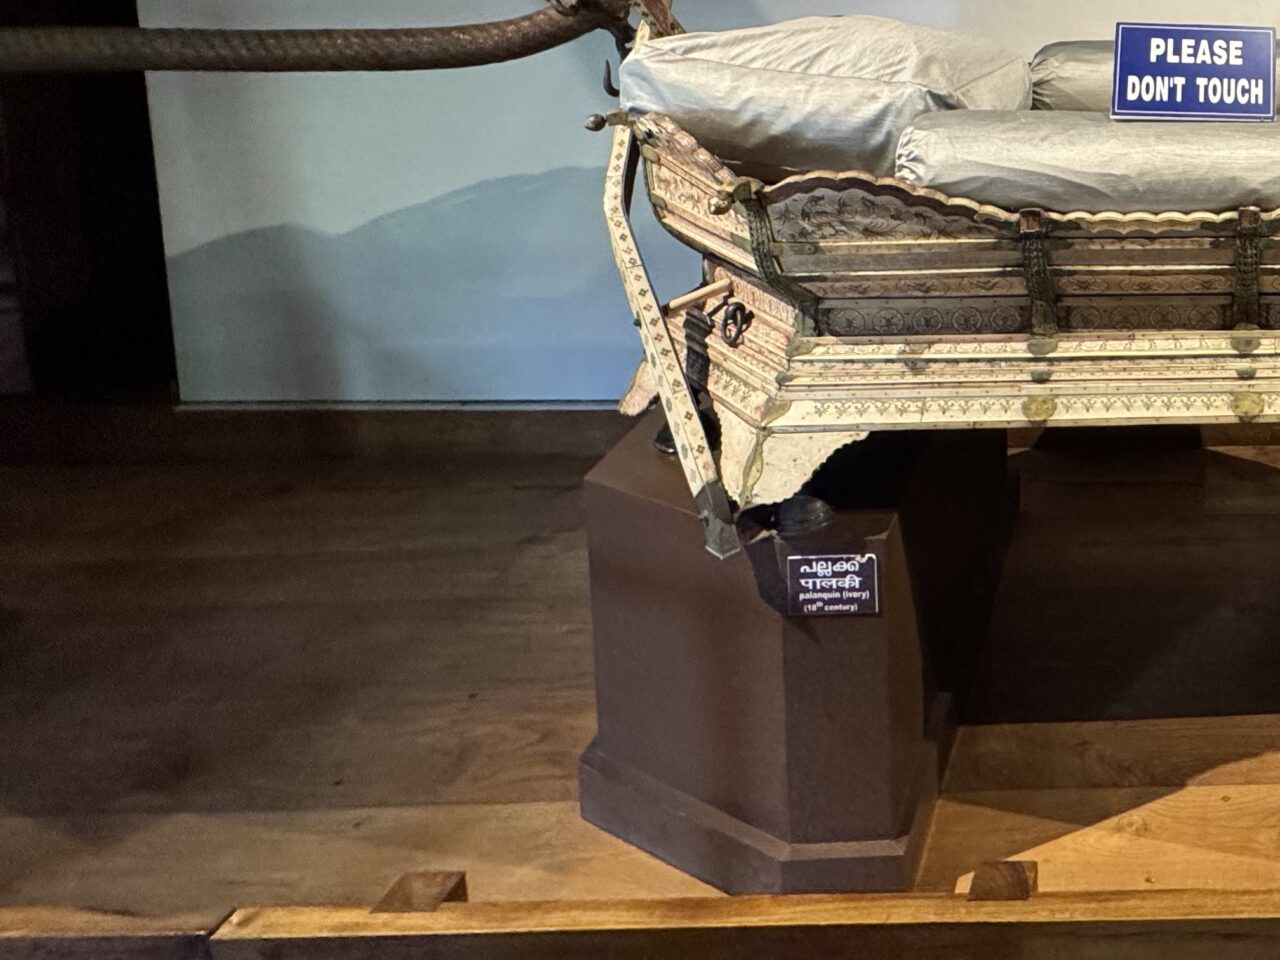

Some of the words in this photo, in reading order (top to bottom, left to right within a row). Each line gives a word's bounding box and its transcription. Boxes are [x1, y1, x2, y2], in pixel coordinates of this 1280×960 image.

[1150, 38, 1243, 65] PLEASE
[1127, 75, 1186, 102] DON'T
[1196, 77, 1264, 104] TOUCH
[799, 574, 862, 589] पालकी
[799, 591, 841, 601] palanquin
[842, 590, 870, 600] (ivory)
[824, 603, 858, 612] century)
